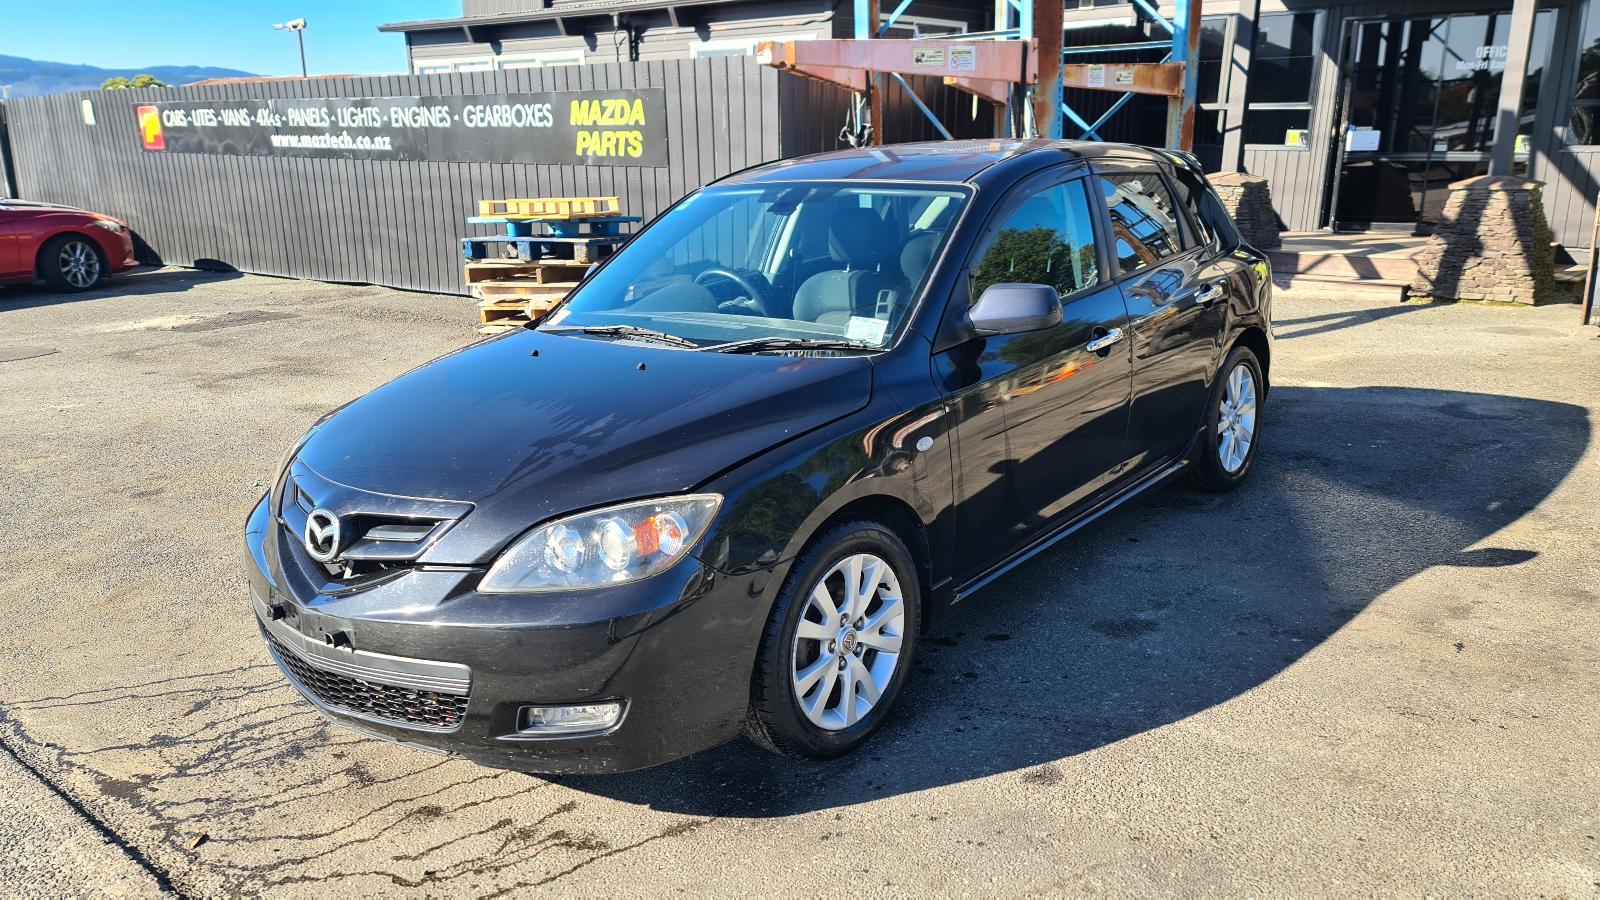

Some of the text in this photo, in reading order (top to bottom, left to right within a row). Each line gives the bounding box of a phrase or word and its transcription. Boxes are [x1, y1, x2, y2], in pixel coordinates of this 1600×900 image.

[1476, 45, 1507, 58] OFFIC
[162, 109, 188, 127] CARS
[191, 108, 217, 127] UTES
[220, 108, 251, 127] VANS
[287, 107, 330, 128] PANELS
[337, 107, 381, 128] LIGHTS
[390, 105, 452, 128] ENGINES
[463, 103, 553, 128] GEARBOXES
[569, 98, 646, 126] MAZDA
[270, 130, 392, 150] www.maztech.co.nz
[575, 130, 643, 158] PARTS
